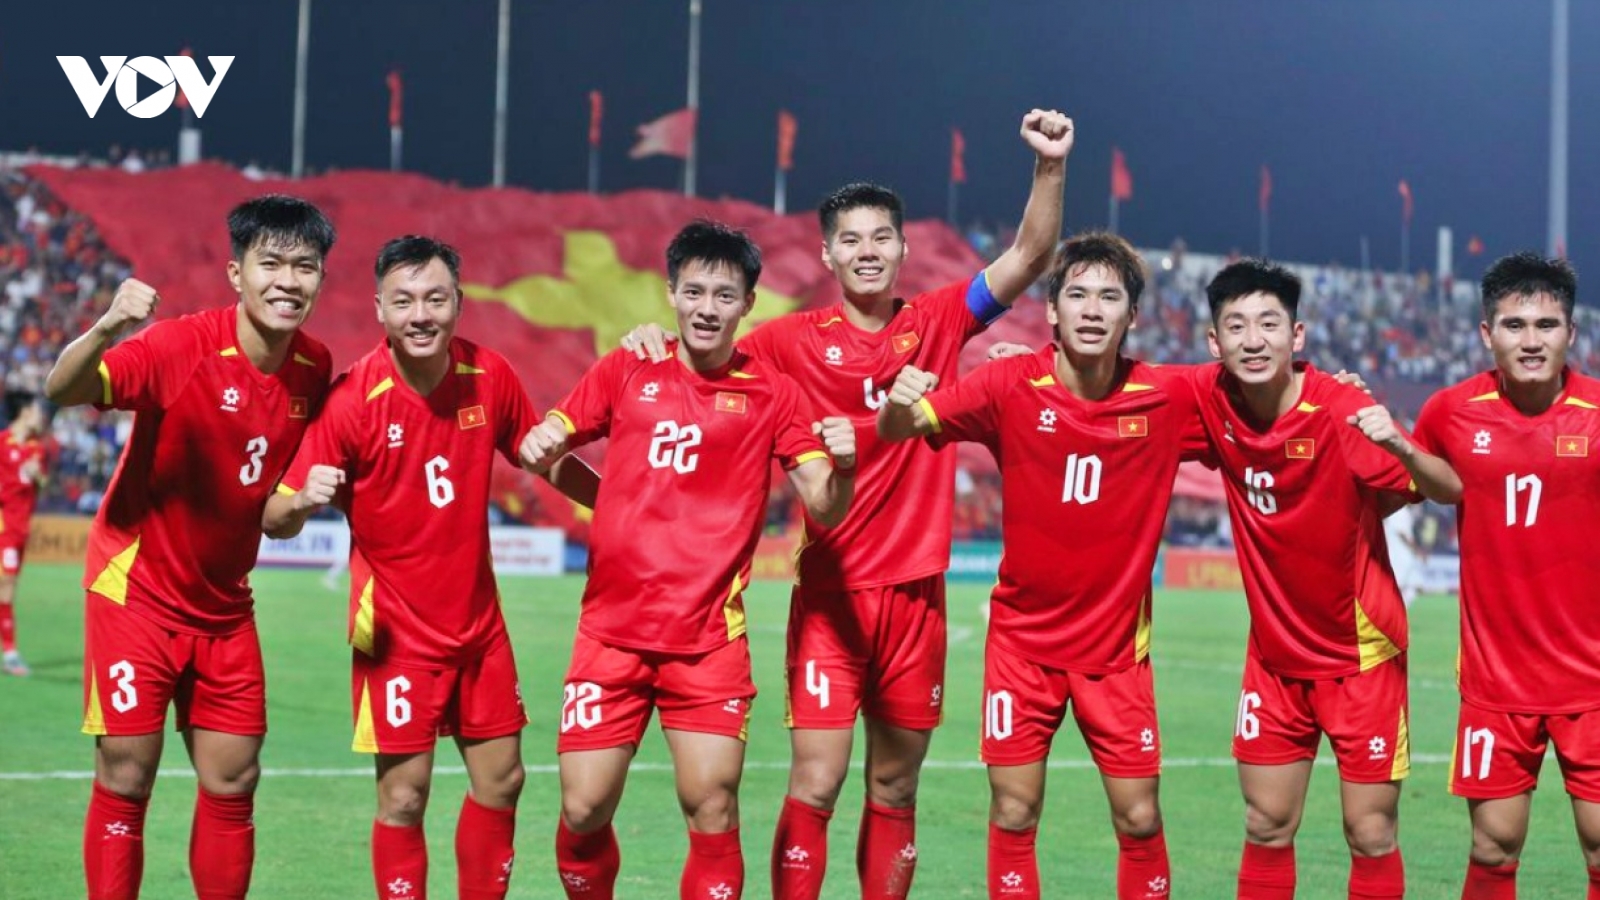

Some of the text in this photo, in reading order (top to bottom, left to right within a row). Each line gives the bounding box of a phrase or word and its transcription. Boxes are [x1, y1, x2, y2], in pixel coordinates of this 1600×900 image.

[240, 436, 268, 485] 3
[648, 420, 703, 474] 22
[425, 455, 455, 508] 6
[1062, 453, 1103, 504] 10
[1245, 467, 1277, 515] 16
[1505, 473, 1542, 527] 17
[110, 660, 137, 712] 3
[386, 676, 412, 727] 6
[561, 682, 602, 733] 22
[806, 660, 829, 708] 4
[986, 690, 1013, 741] 10
[1235, 689, 1262, 740] 16
[1462, 726, 1495, 780] 17
